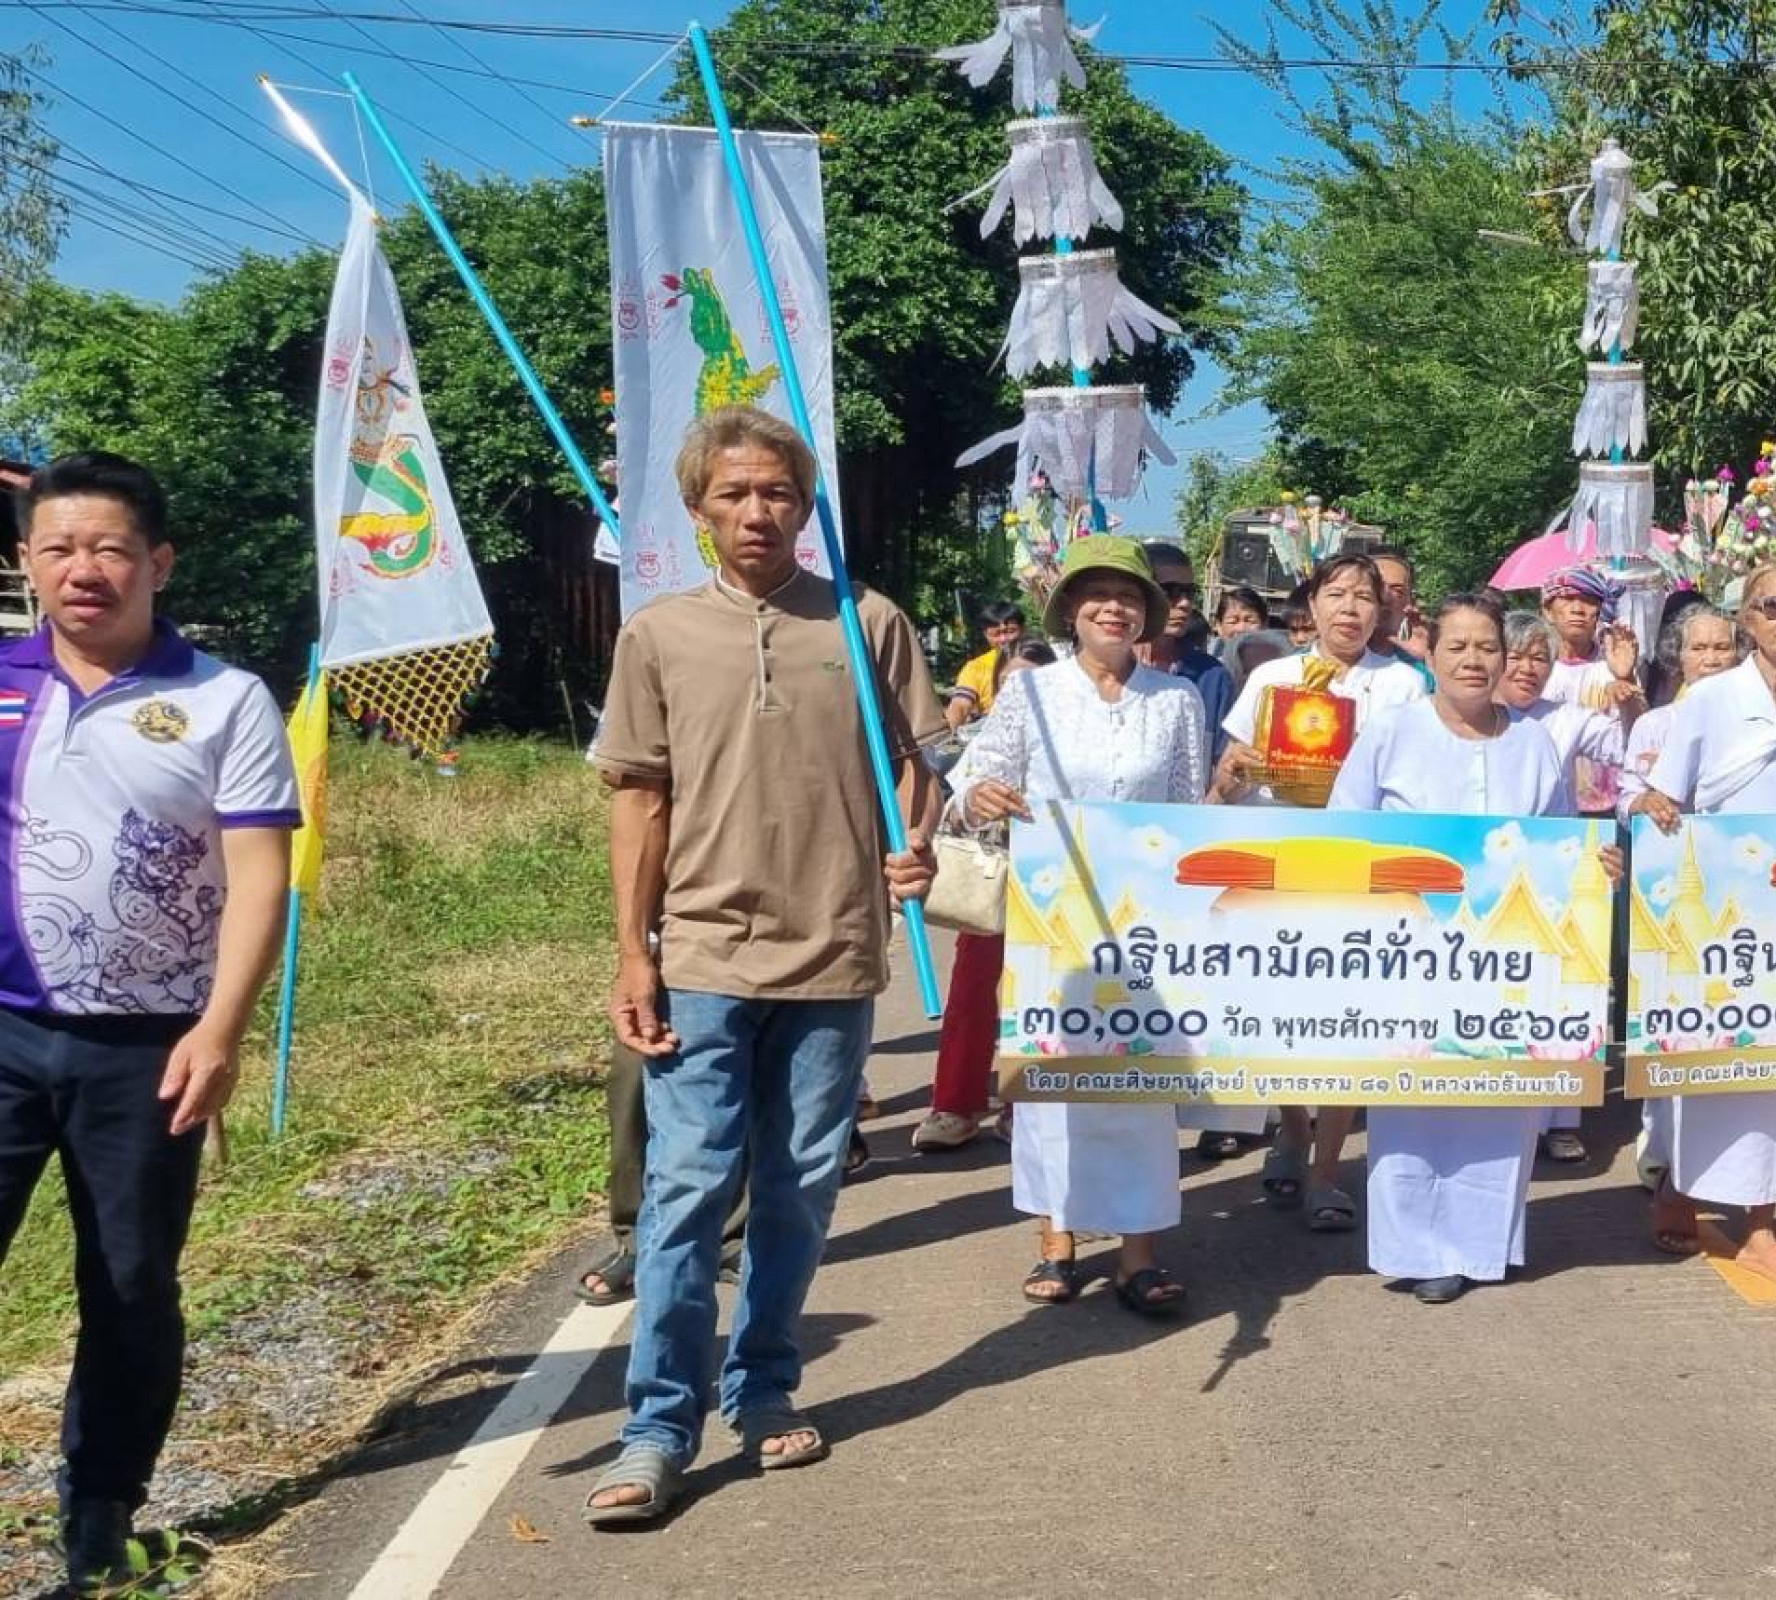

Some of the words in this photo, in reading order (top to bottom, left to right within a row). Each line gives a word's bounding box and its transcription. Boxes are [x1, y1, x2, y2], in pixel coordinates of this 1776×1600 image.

[1092, 919, 1533, 990] กฐินสามัคคีทั่วไทย
[1023, 1004, 1208, 1043] ๓๐,๐๐๐
[1222, 1004, 1262, 1037] วัด
[1272, 1006, 1439, 1049] พุทธศักราช
[1453, 1007, 1591, 1043] ๒๕๖๘
[1027, 1067, 1069, 1090] โดย
[1399, 1071, 1413, 1092] ปี
[1649, 1064, 1684, 1085] โดย
